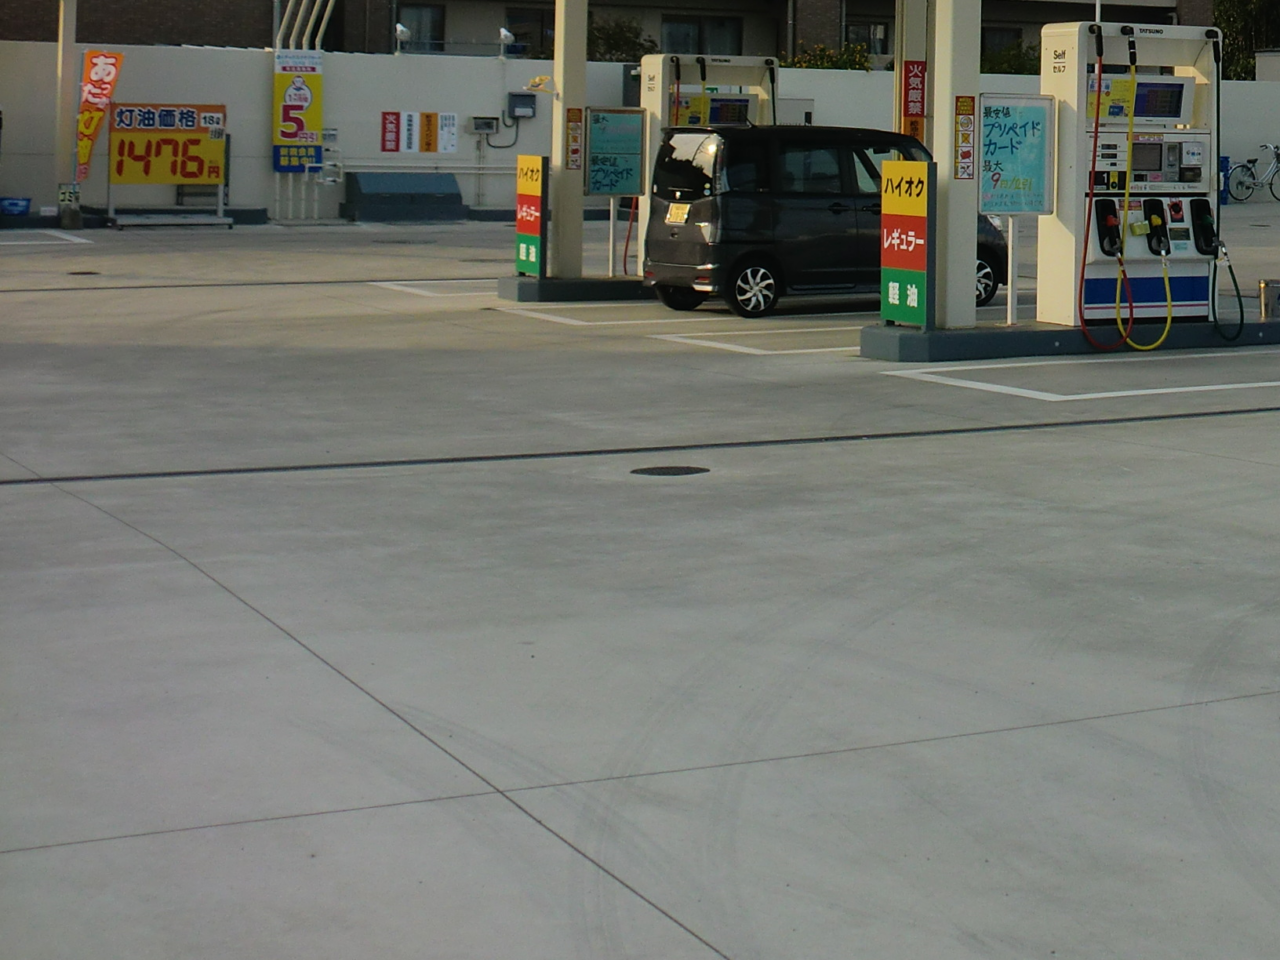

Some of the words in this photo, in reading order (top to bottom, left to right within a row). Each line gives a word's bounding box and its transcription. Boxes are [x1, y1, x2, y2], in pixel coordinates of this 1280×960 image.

[1053, 50, 1066, 60] Self
[1053, 65, 1066, 73] セルフ
[908, 64, 922, 114] 火気厳禁
[116, 108, 196, 128] 灯油価格
[984, 121, 1041, 138] プリペイド
[984, 138, 1022, 155] カード
[518, 166, 540, 182] ハイオク
[982, 160, 1004, 172] 最大
[1102, 172, 1108, 183] 1
[884, 176, 924, 198] ハイオク
[517, 203, 540, 222] レギュラー
[883, 228, 924, 252] レギュラー
[888, 281, 918, 308] 軽油
